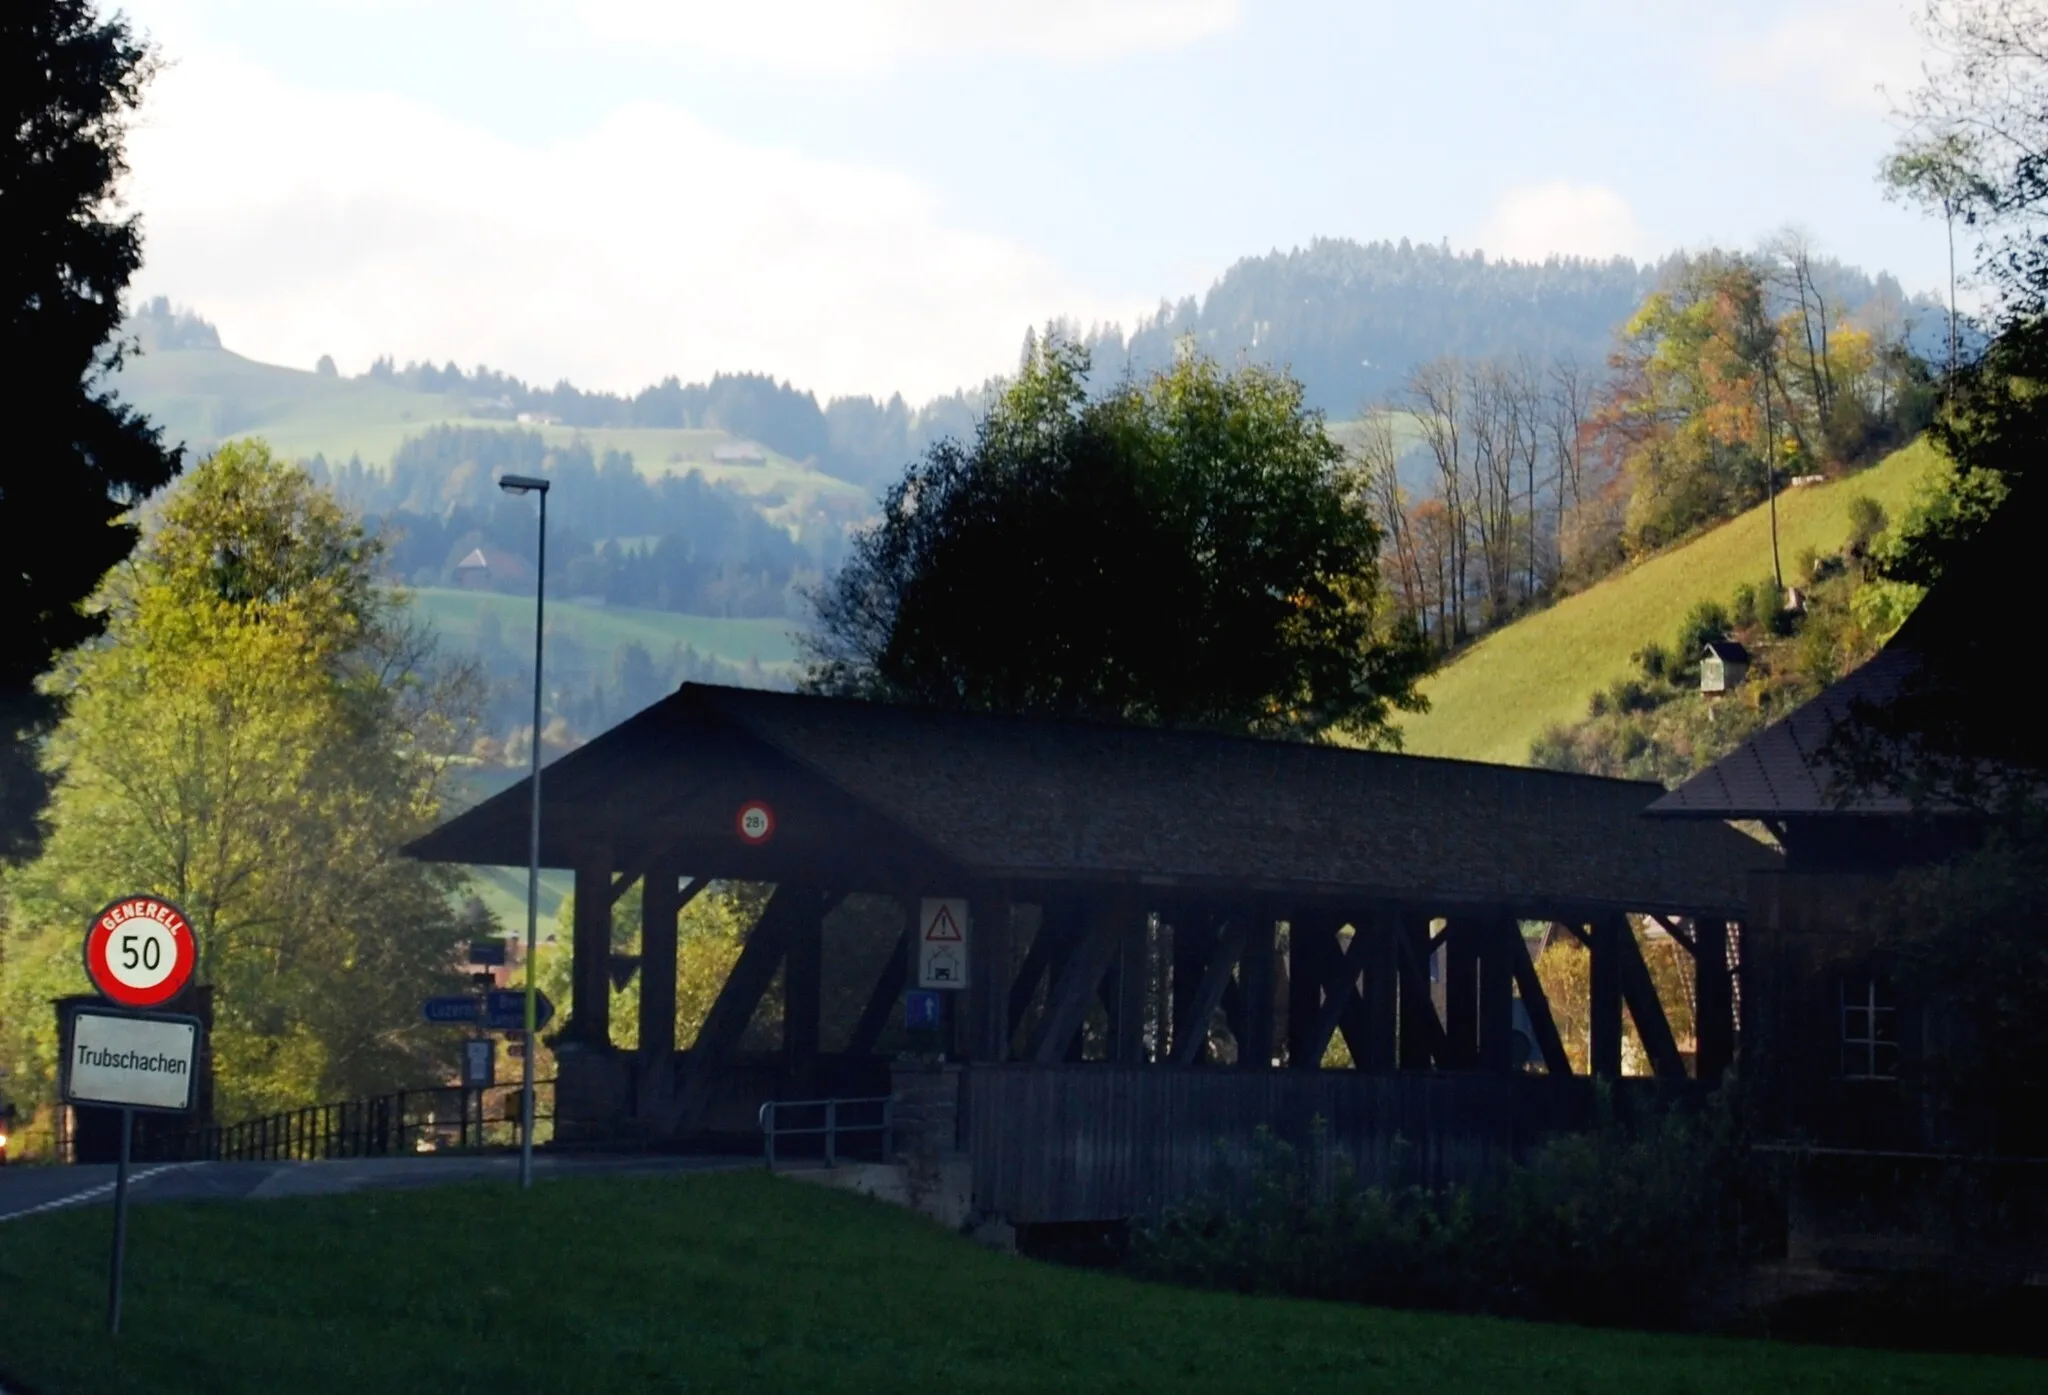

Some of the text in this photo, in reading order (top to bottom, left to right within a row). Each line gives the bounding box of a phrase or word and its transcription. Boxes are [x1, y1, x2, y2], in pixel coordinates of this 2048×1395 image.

[102, 902, 184, 936] GENERELL
[122, 935, 160, 971] 50
[78, 1045, 187, 1075] Trubschachen
